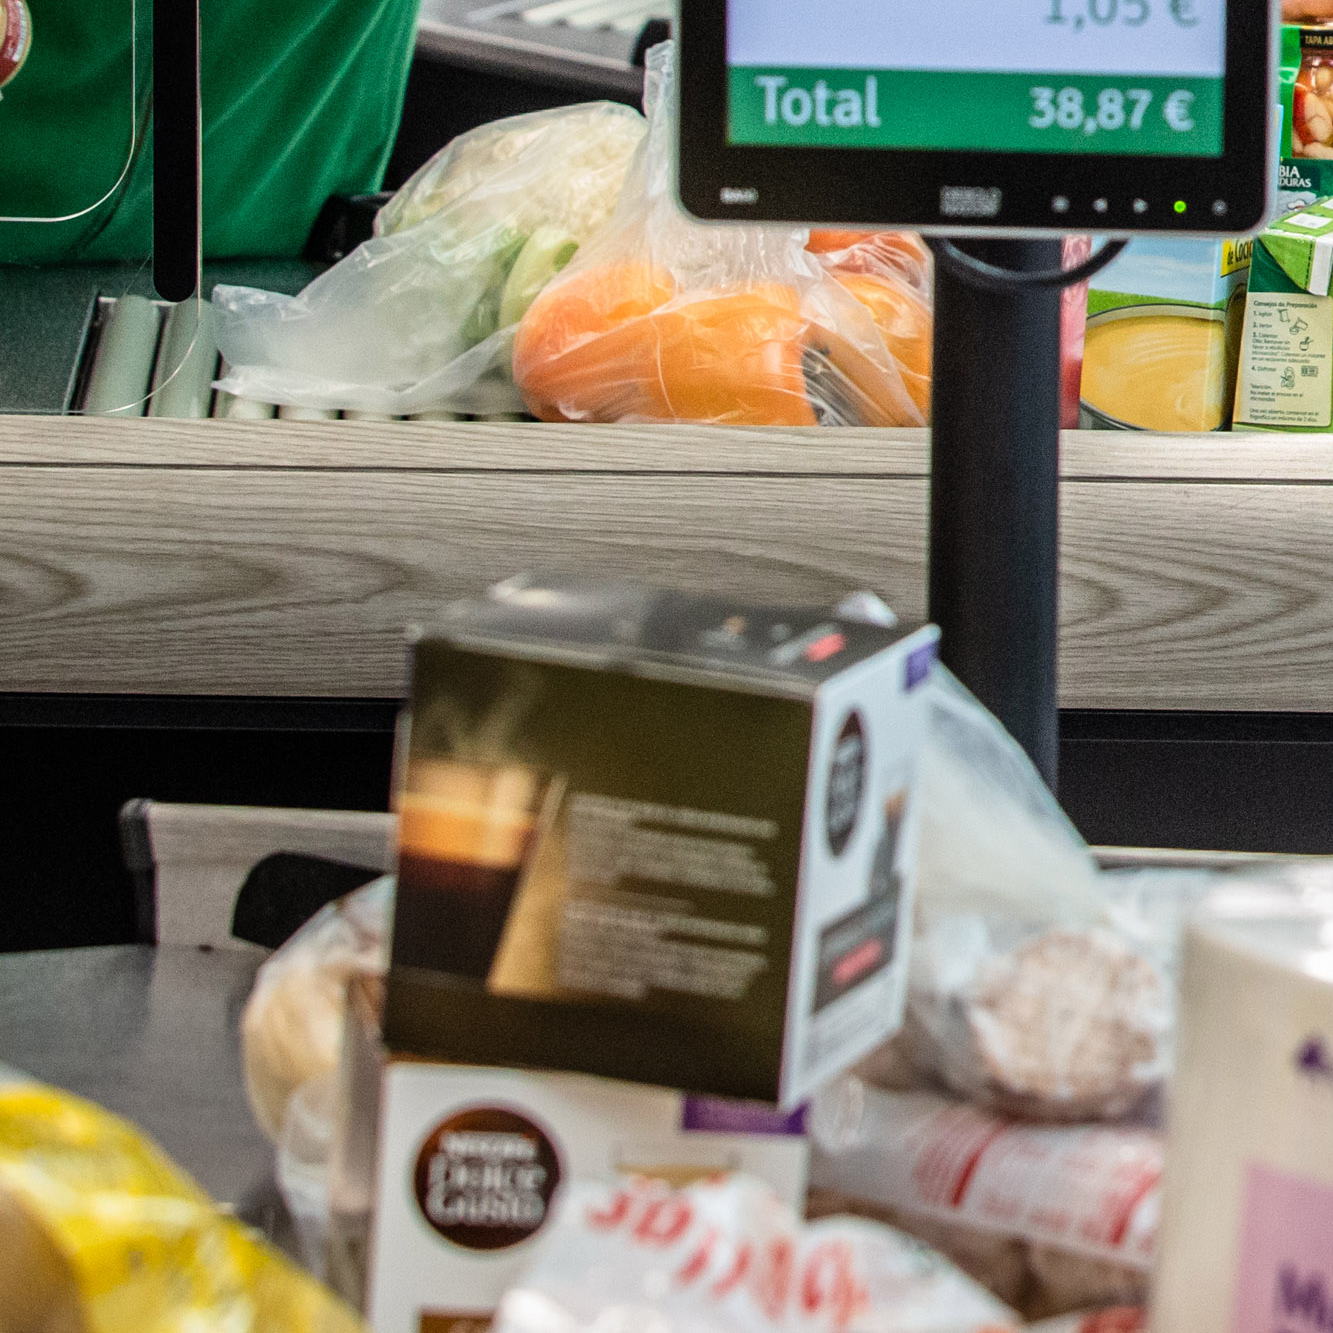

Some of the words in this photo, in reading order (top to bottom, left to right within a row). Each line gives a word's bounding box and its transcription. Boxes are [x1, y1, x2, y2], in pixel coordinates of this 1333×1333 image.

[1305, 35, 1323, 45] TAPA
[753, 74, 882, 129] Total
[1028, 85, 1154, 135] 38,87
[1163, 89, 1196, 133] €
[1278, 165, 1300, 178] BIA
[1278, 177, 1312, 188] DURAS
